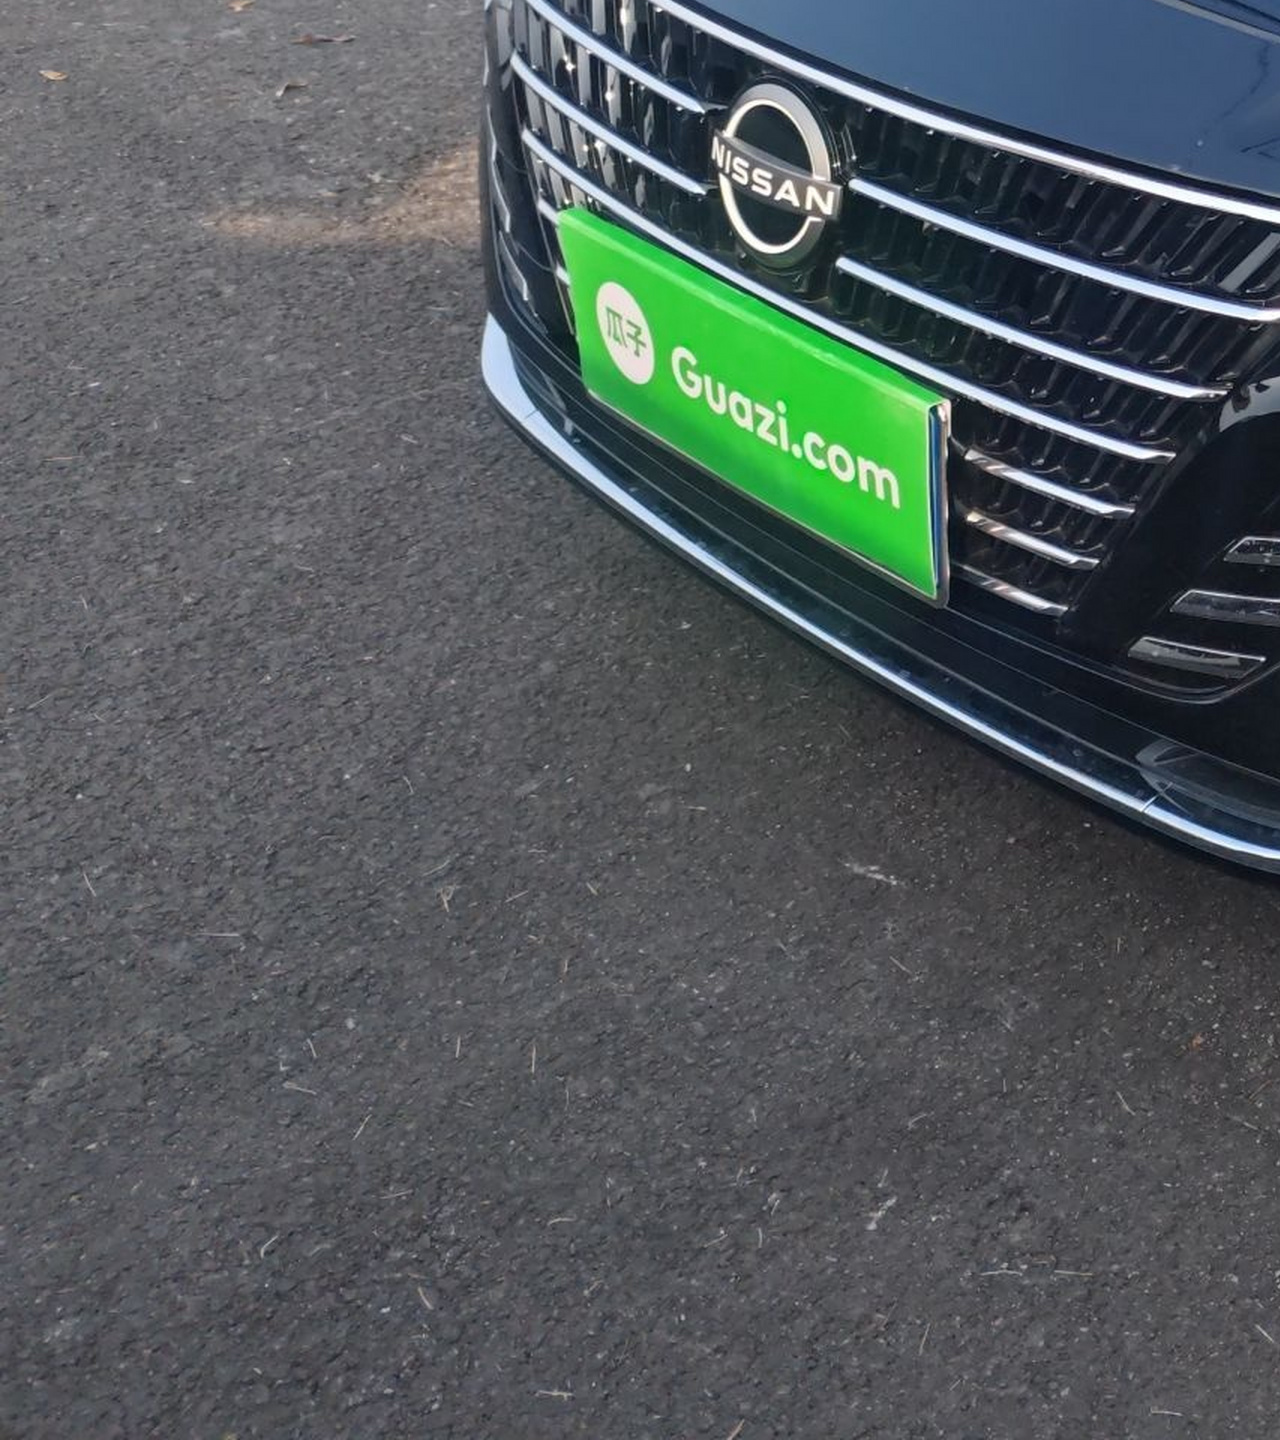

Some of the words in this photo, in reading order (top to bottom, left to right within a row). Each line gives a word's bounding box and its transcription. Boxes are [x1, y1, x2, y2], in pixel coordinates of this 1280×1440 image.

[712, 136, 836, 218] NISSAN
[605, 306, 648, 359] 瓜子
[671, 347, 901, 509] Guazi.com
